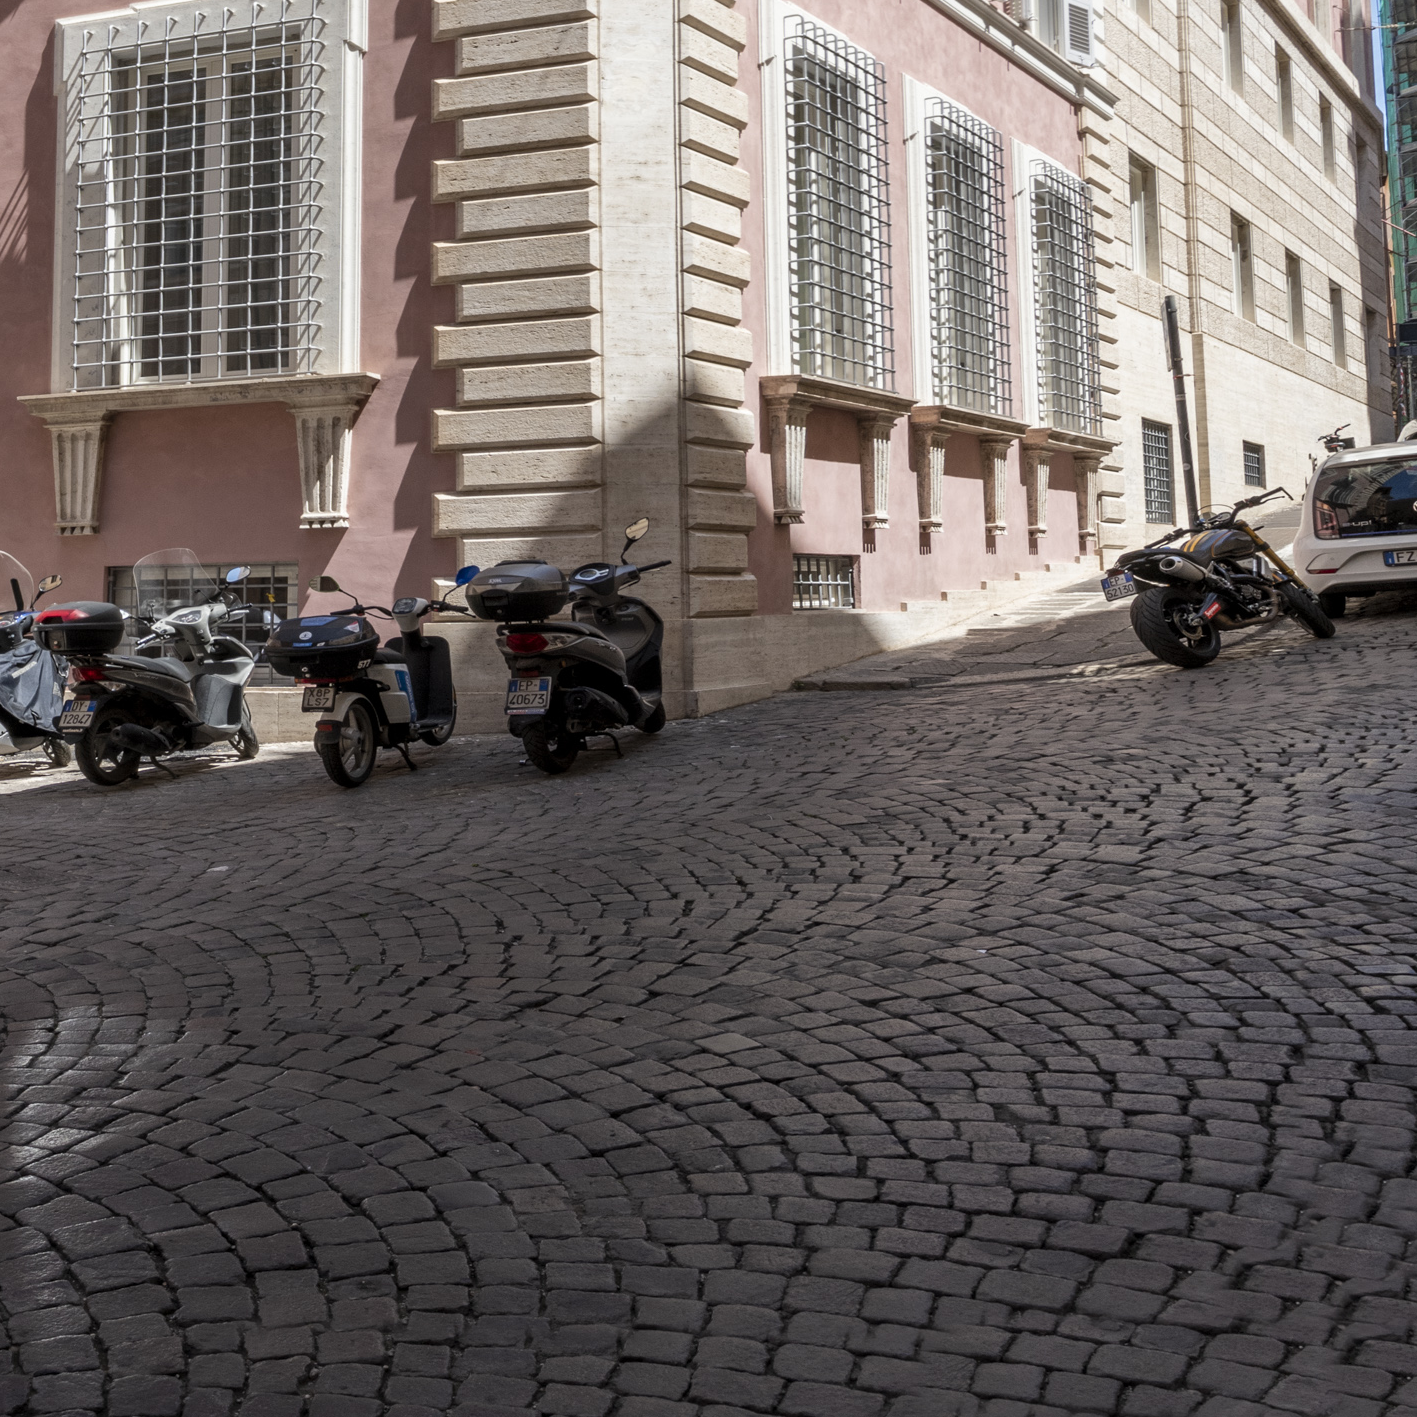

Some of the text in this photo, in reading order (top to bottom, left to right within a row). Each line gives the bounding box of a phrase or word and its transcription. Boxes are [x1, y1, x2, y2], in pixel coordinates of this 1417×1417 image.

[1396, 552, 1416, 562] FZ
[1107, 584, 1134, 598] 52130
[357, 659, 371, 669] 577
[519, 680, 533, 691] EP
[308, 688, 331, 698] X8P
[307, 698, 329, 706] LS7
[509, 693, 545, 705] 40673
[62, 714, 92, 724] 12847
